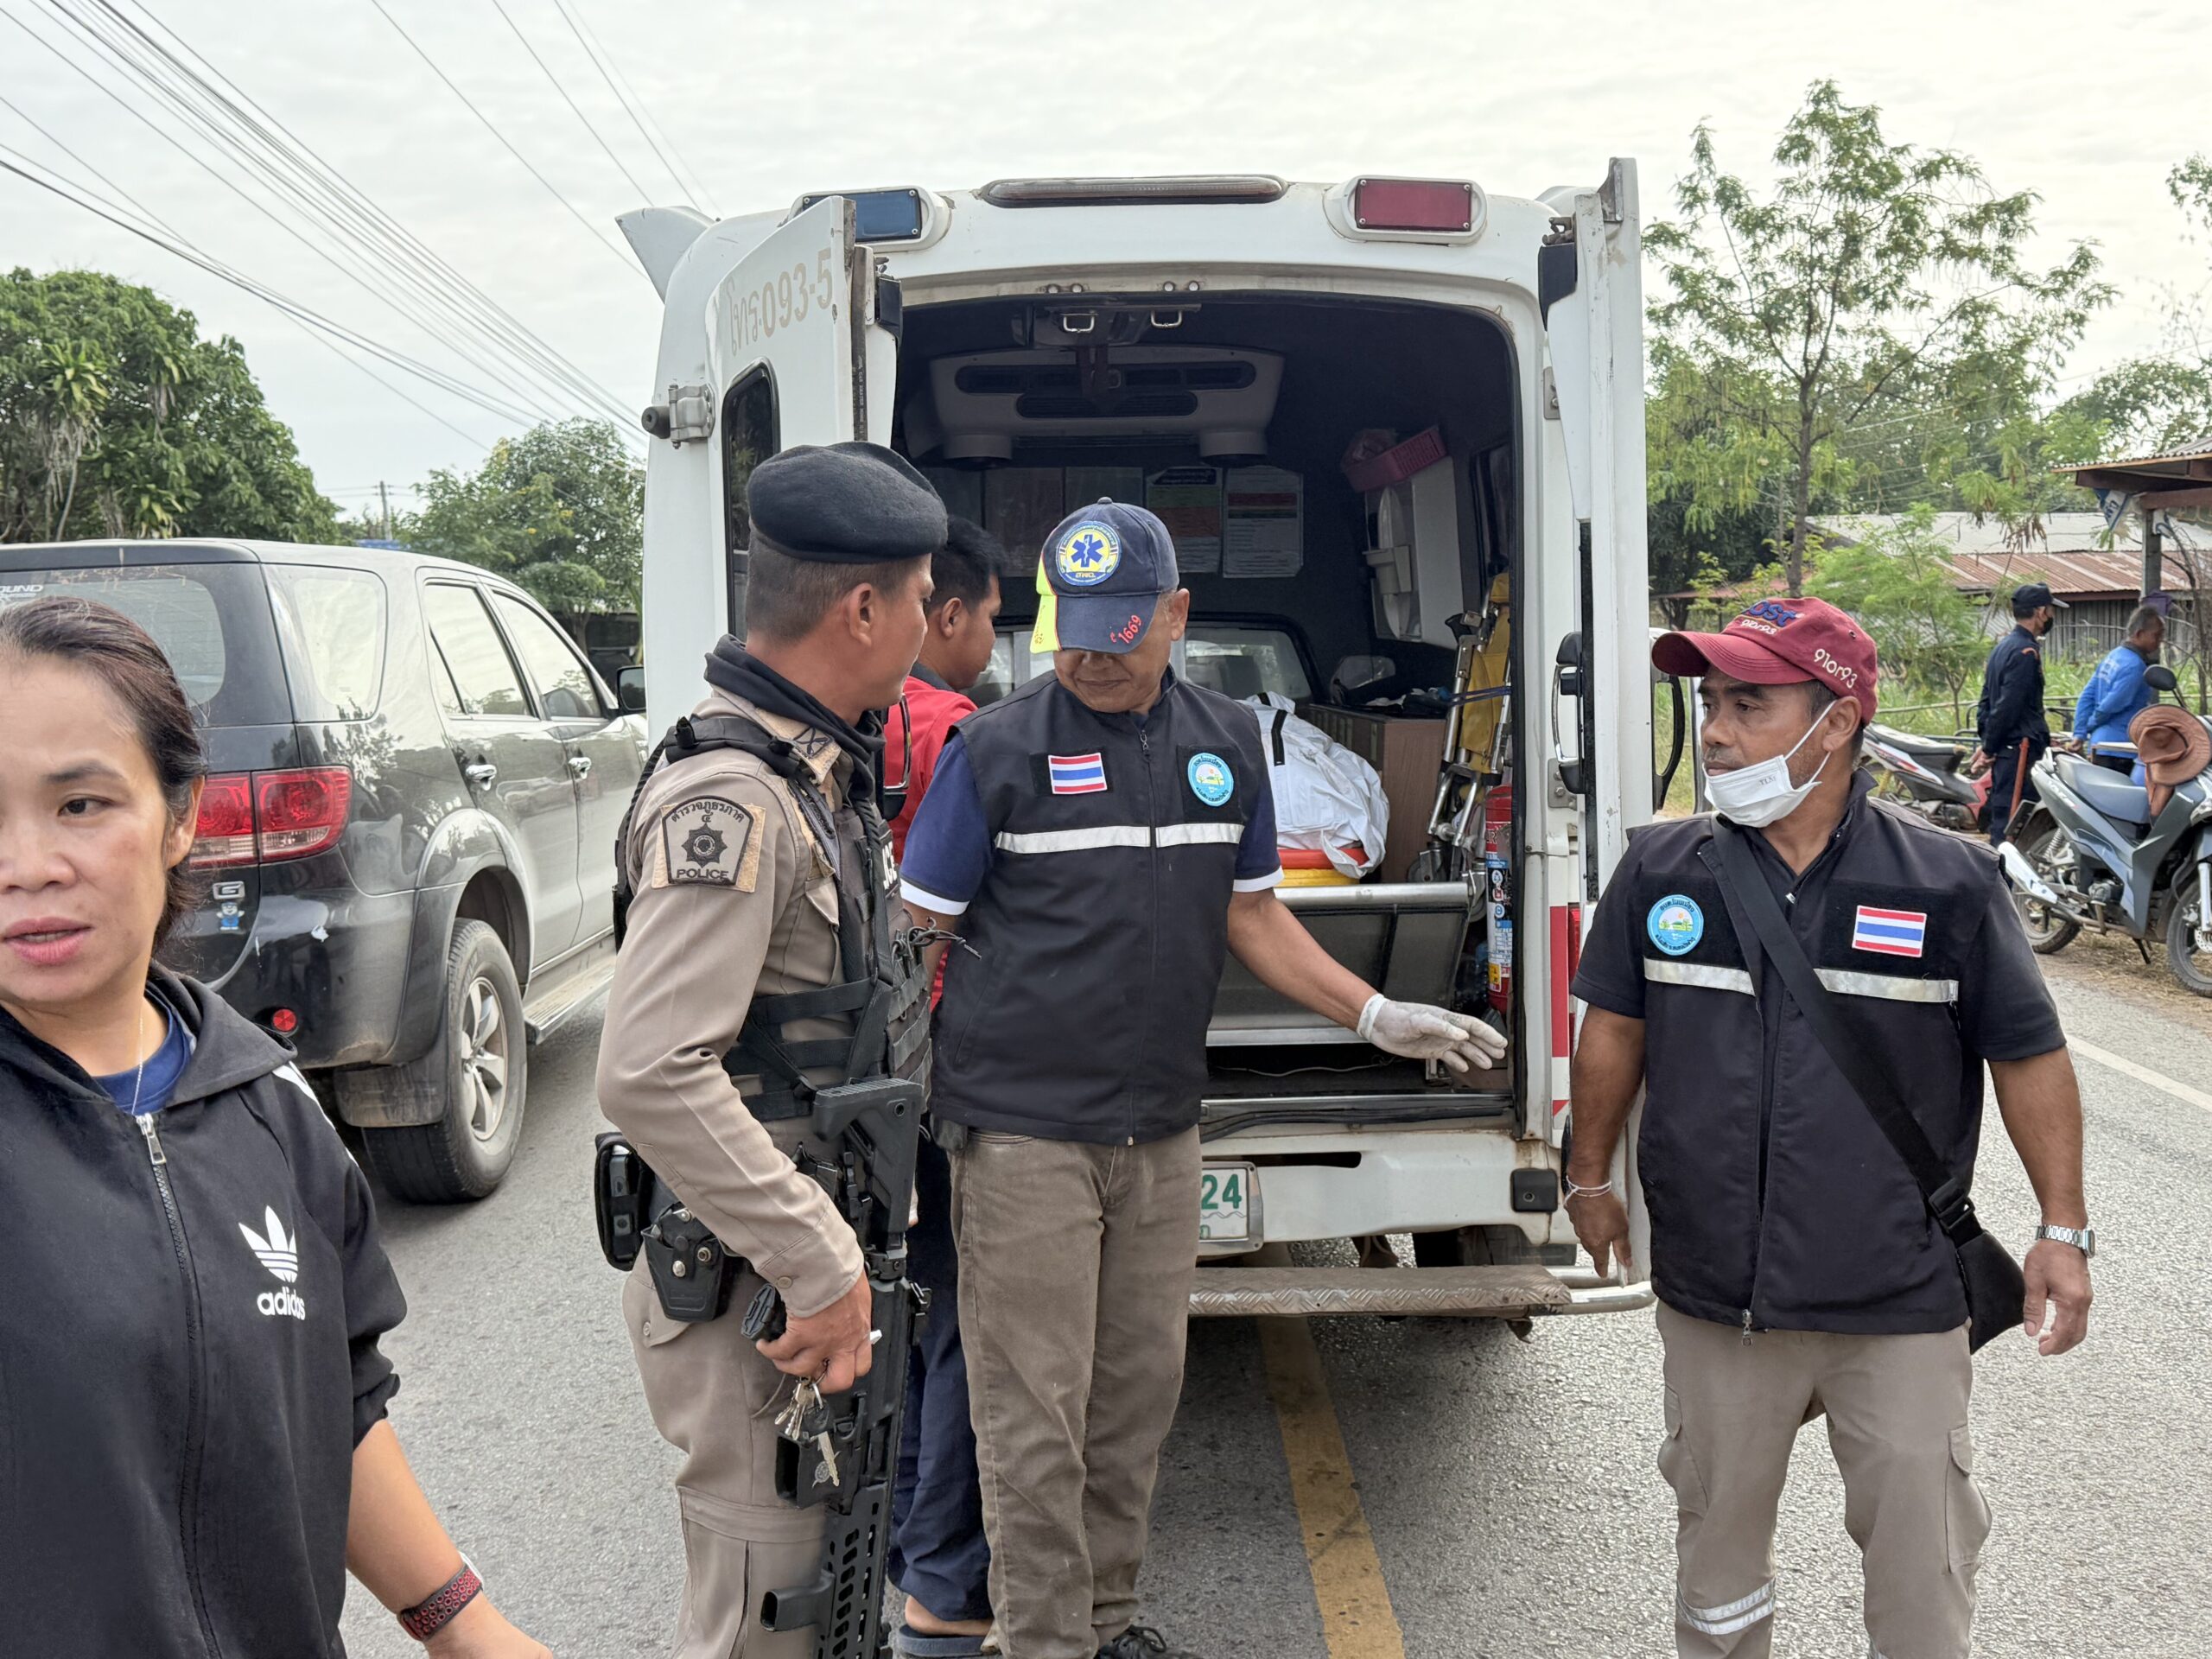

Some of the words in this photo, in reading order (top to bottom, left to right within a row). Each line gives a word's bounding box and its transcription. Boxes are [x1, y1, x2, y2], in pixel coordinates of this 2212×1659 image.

[1118, 614, 1141, 644] 1669
[676, 868, 729, 880] POLICE
[1201, 1173, 1243, 1210] 24
[257, 1286, 306, 1321] adidas
